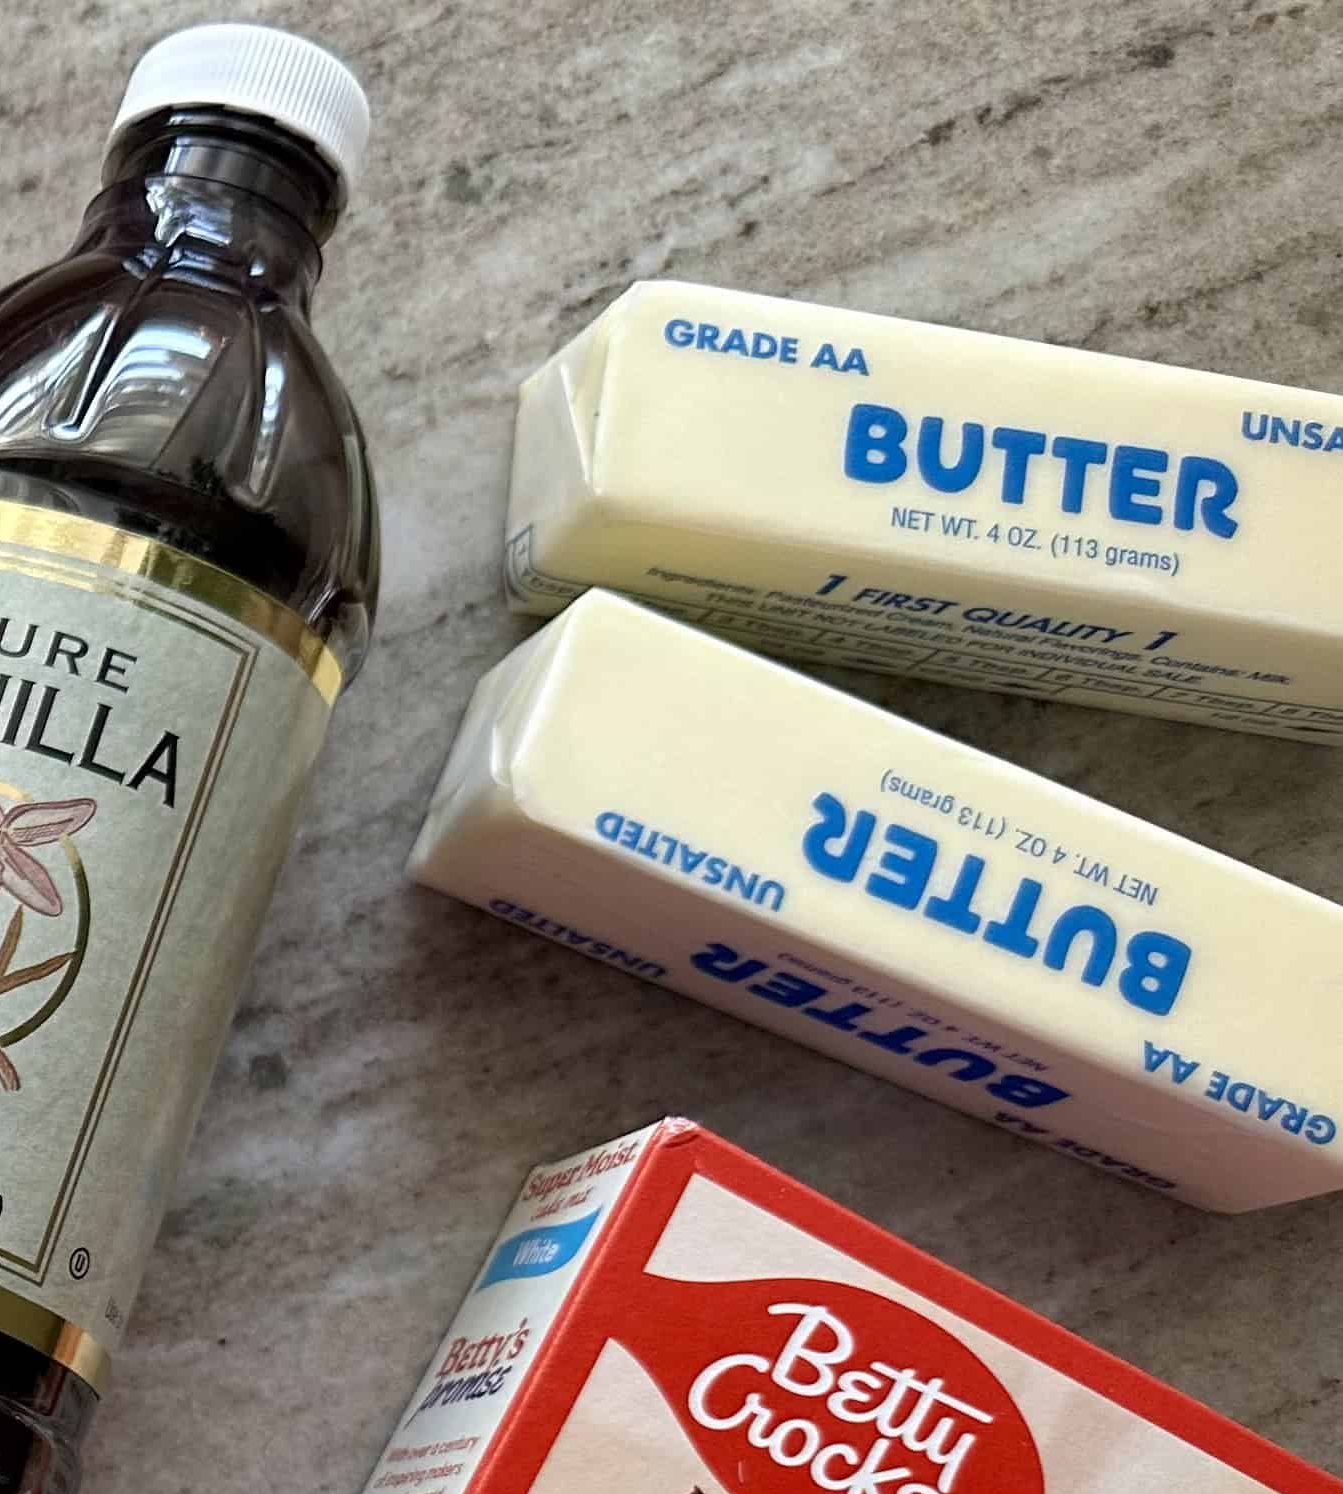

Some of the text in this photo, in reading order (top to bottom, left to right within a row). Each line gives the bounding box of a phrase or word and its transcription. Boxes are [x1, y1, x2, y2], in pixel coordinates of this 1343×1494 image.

[664, 317, 871, 378] GRADE AA
[844, 402, 1241, 540] BUTTER
[890, 506, 1181, 577] NET WT. 4 OZ. (113 grams)
[815, 573, 1180, 652] 1 FIRST QUALITY 1
[1017, 647, 1139, 676] INDIVIDUAL
[1142, 667, 1203, 687] SALE
[595, 809, 786, 914] UNSALTED
[880, 769, 1160, 906] NET WT. 4 OZ. (113 grams)
[489, 898, 668, 978] UNSALTED
[802, 792, 1193, 1017] BUTTER
[689, 943, 1074, 1110] BUTTER
[1144, 1039, 1337, 1145] GRADE AA
[994, 1110, 1179, 1191] GRADE AA
[513, 1238, 562, 1267] White
[435, 1317, 531, 1380] Betty's
[403, 1365, 514, 1431] promise
